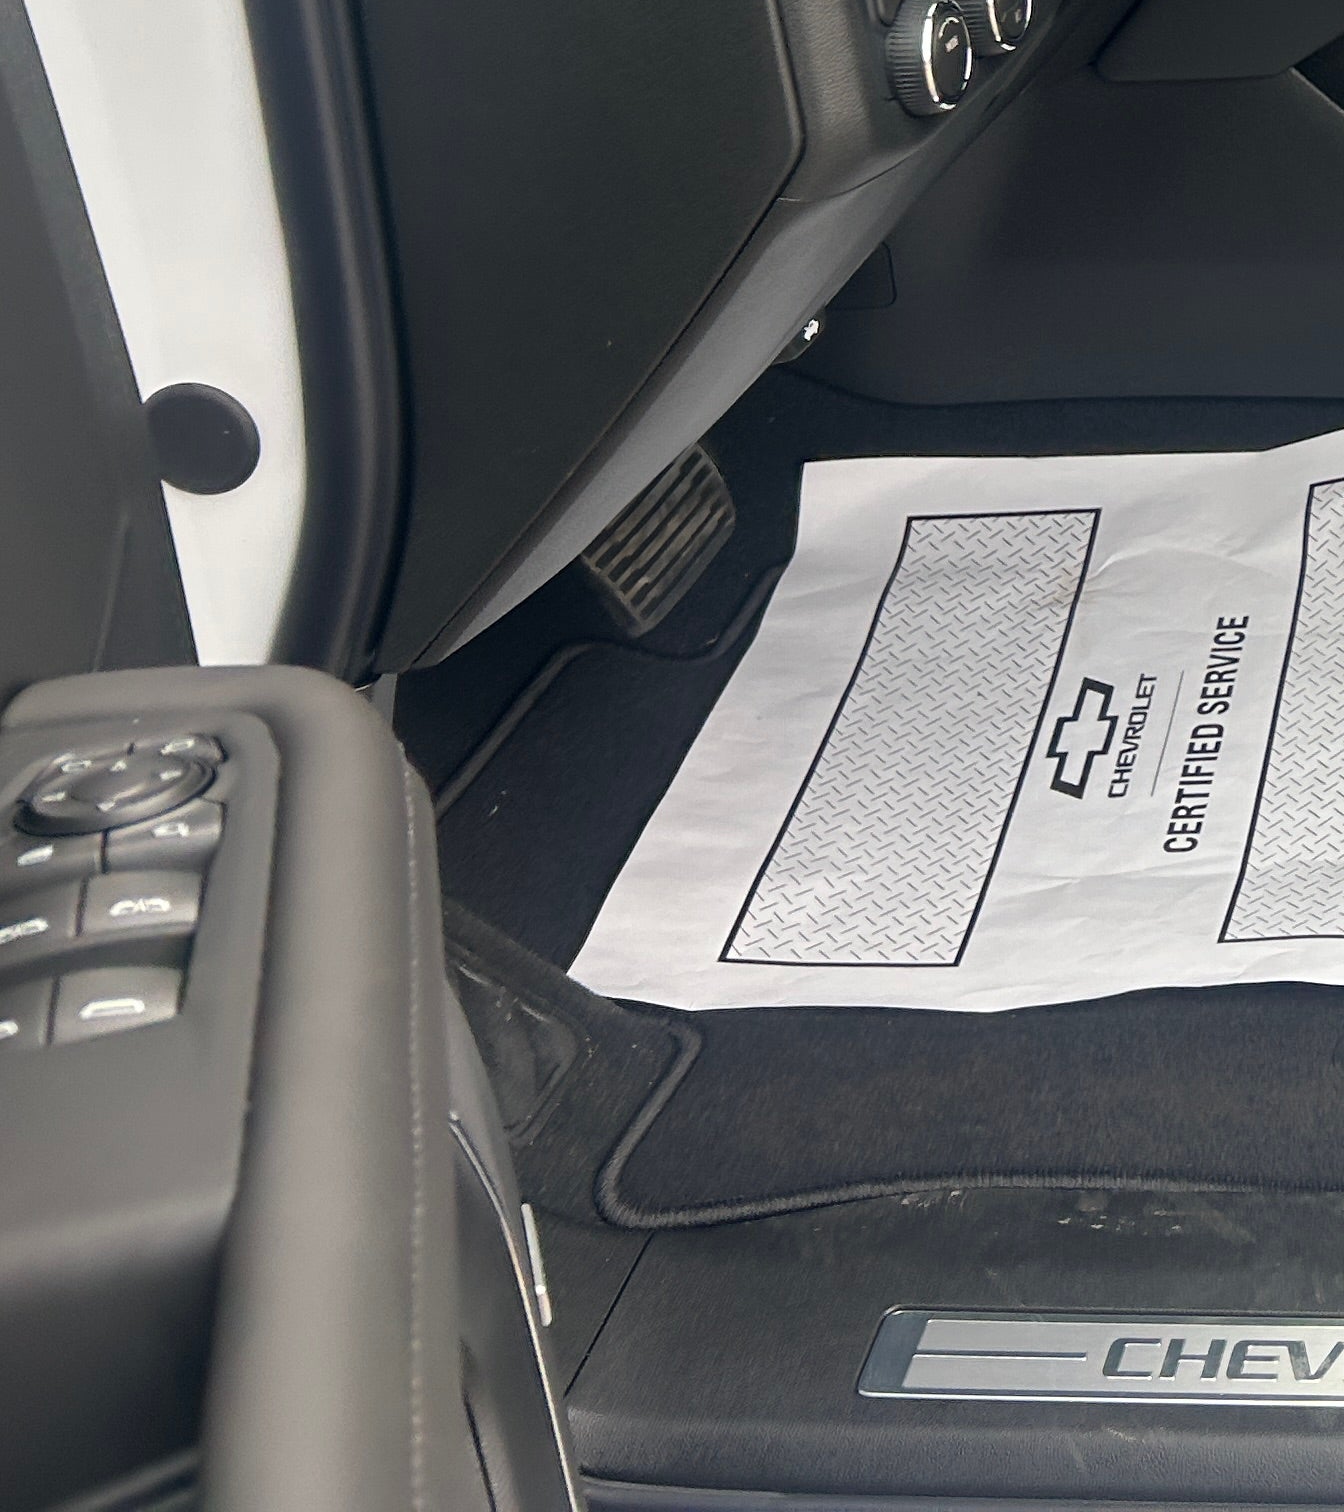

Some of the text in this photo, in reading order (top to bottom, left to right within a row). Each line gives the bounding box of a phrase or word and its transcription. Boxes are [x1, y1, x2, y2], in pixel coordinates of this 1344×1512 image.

[1107, 673, 1157, 798] CHEVROLET
[1163, 615, 1249, 853] CERTIFIED SERVICE
